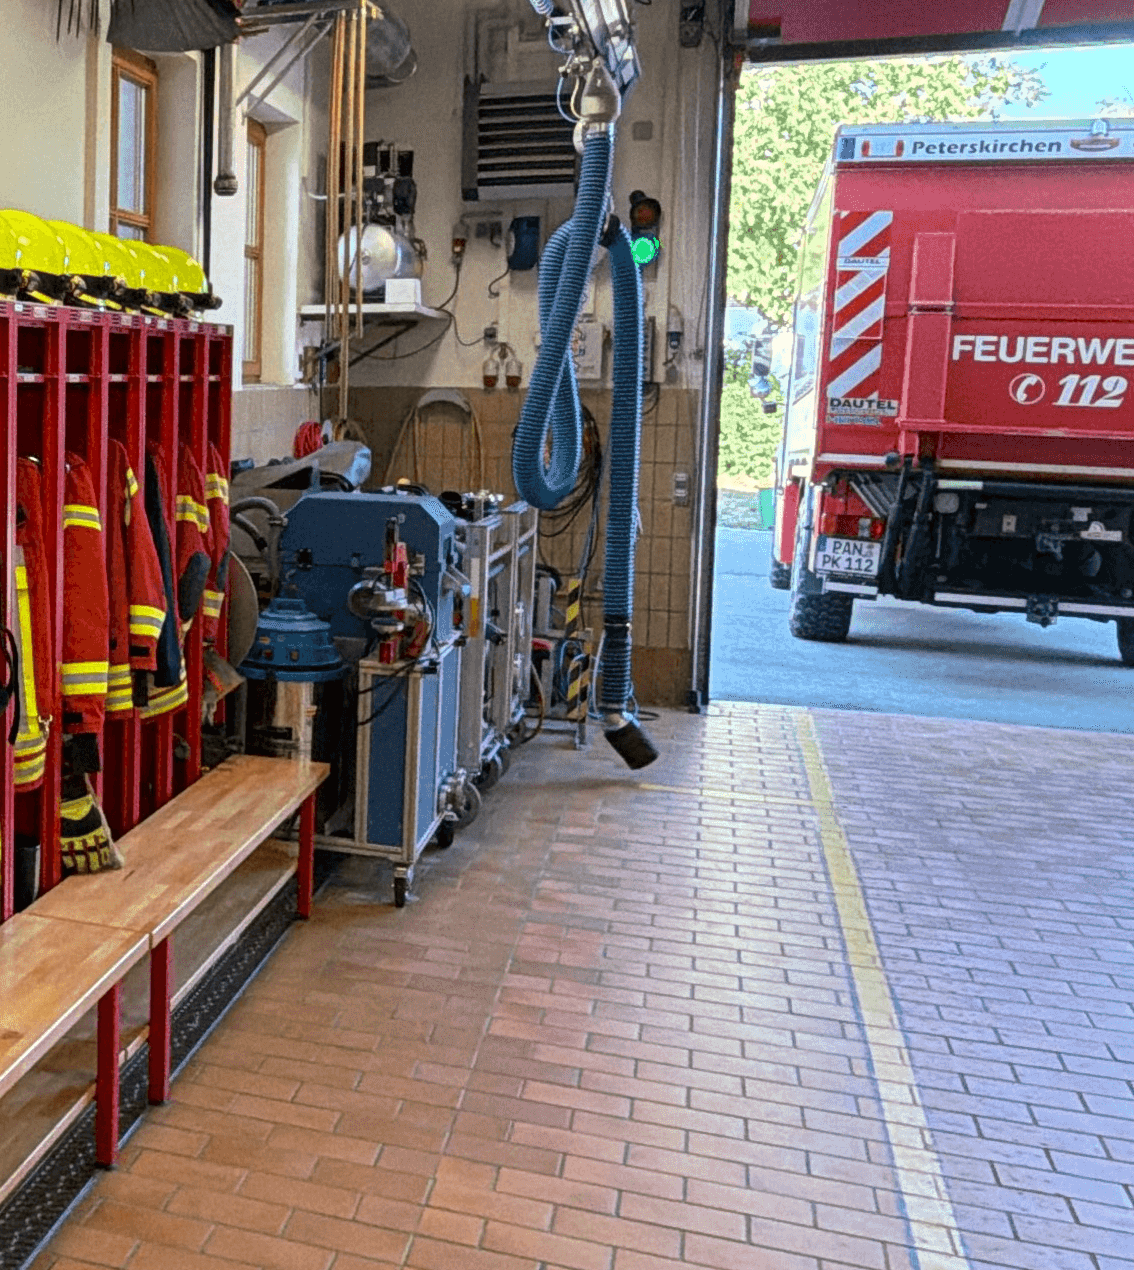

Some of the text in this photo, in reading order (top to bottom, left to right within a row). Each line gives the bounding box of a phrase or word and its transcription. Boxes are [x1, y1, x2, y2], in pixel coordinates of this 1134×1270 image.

[912, 139, 1062, 155] Peterskirchen
[952, 334, 1134, 366] FEUERWE
[1051, 373, 1129, 408] 112
[830, 398, 896, 410] DAUTEL
[832, 540, 863, 556] PAN
[822, 554, 873, 573] PK 112
